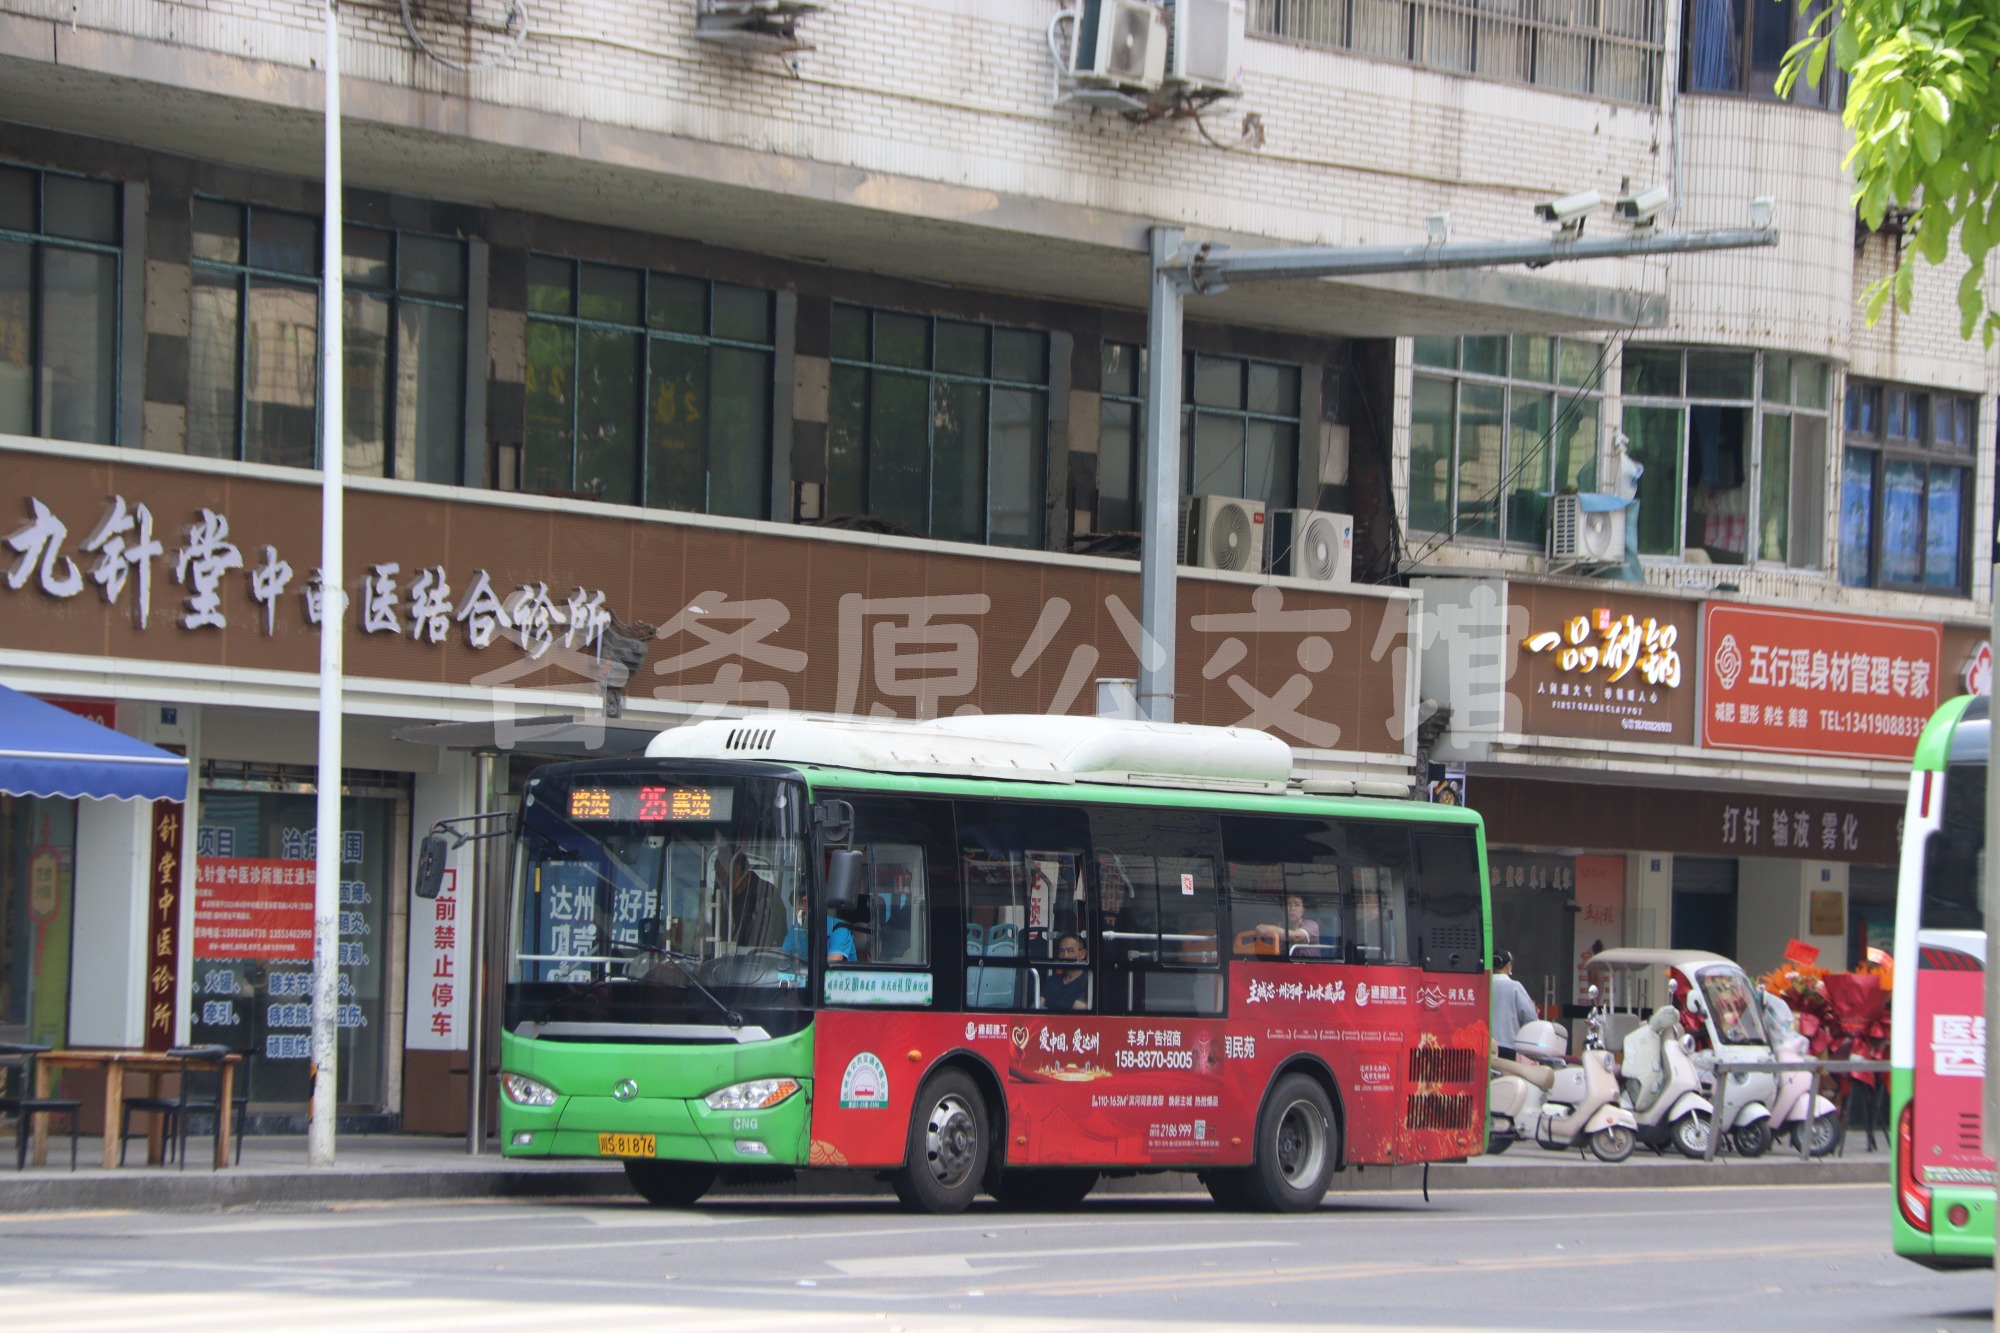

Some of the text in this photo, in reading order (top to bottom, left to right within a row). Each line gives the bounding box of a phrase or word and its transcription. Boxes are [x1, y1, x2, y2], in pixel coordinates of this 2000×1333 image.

[1522, 612, 1682, 688] 一品砂锅
[1749, 644, 1931, 699] 五行瑶身材管理专家
[1714, 702, 1736, 723] 减肥
[1738, 704, 1760, 725] 塑形
[1763, 705, 1784, 727] 养生
[1787, 707, 1808, 729] 美容
[638, 786, 667, 821] 25
[1722, 805, 1761, 846] 打针
[1772, 807, 1810, 848] 输液
[1821, 811, 1859, 851] 雾化
[1126, 1029, 1182, 1048] 车身广告招商
[1114, 1049, 1193, 1069] 158-8370-5005
[733, 1118, 758, 1130] CNG
[1160, 1124, 1178, 1137] 2186
[1178, 1124, 1192, 1137] 999
